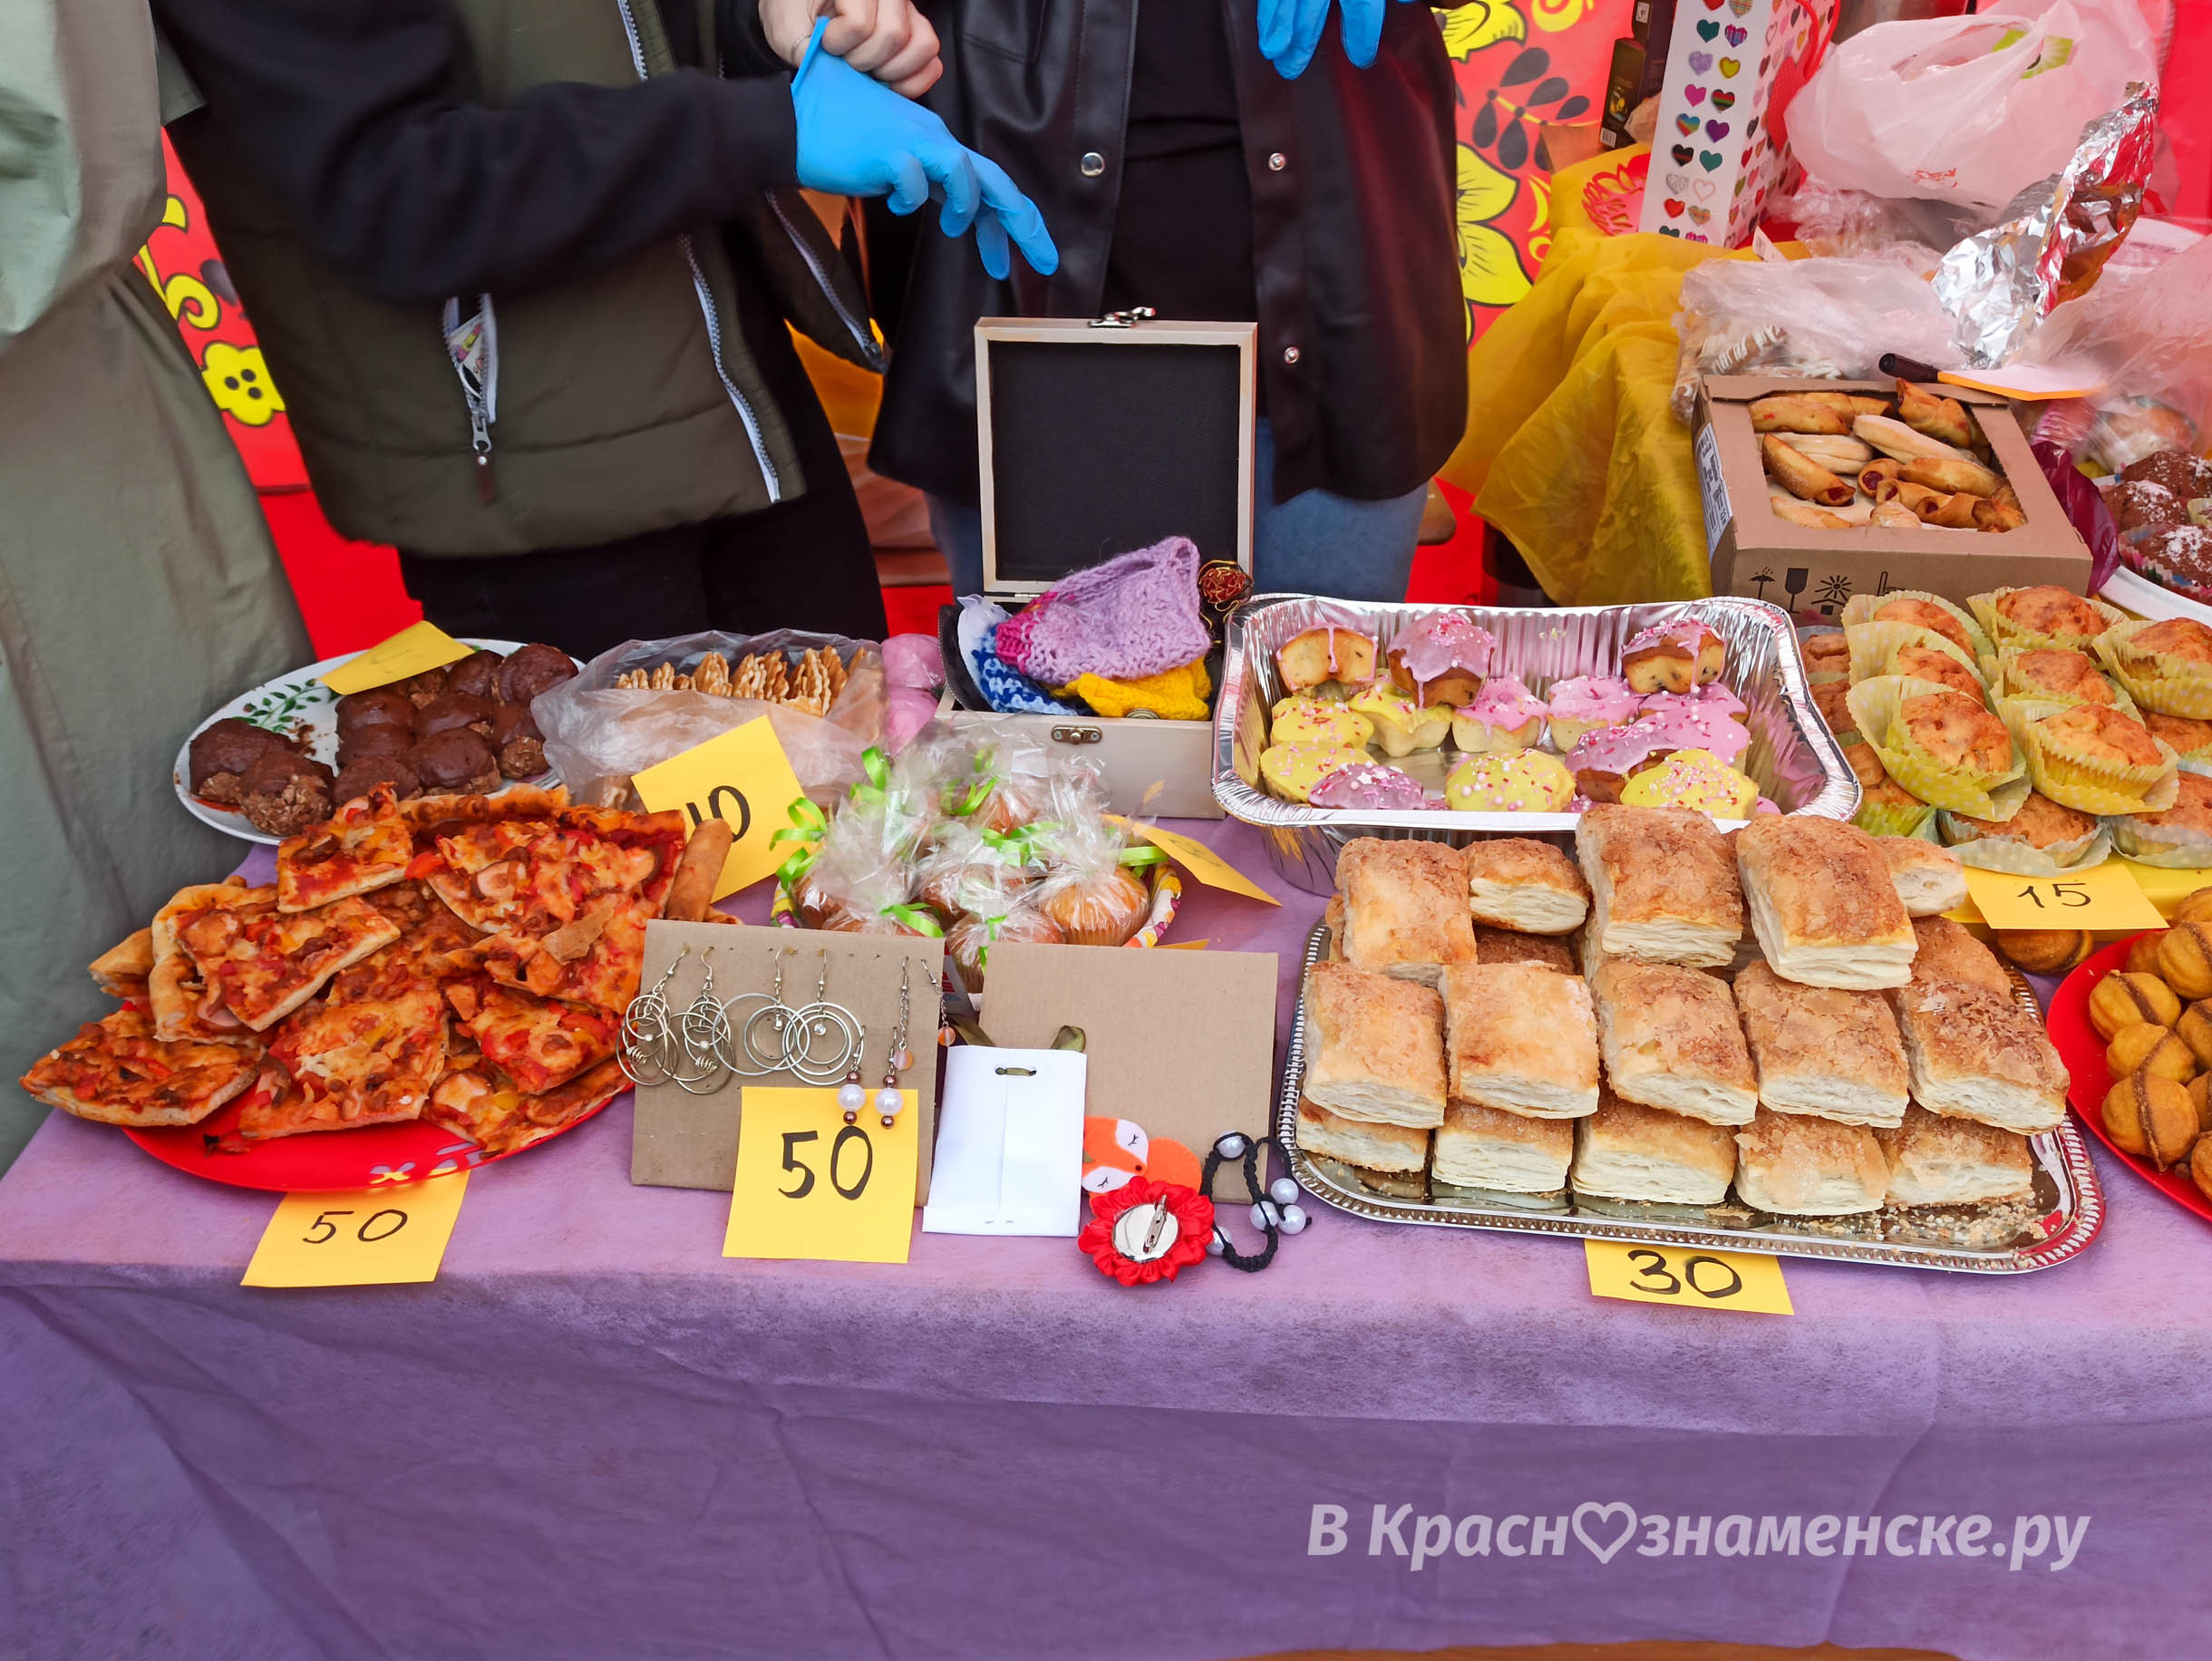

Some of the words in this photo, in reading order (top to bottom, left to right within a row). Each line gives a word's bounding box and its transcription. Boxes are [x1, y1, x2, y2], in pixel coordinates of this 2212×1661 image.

[2016, 882, 2091, 908] 15
[777, 1124, 873, 1201] 50
[302, 1209, 408, 1244] 50
[1627, 1248, 1742, 1299] 30
